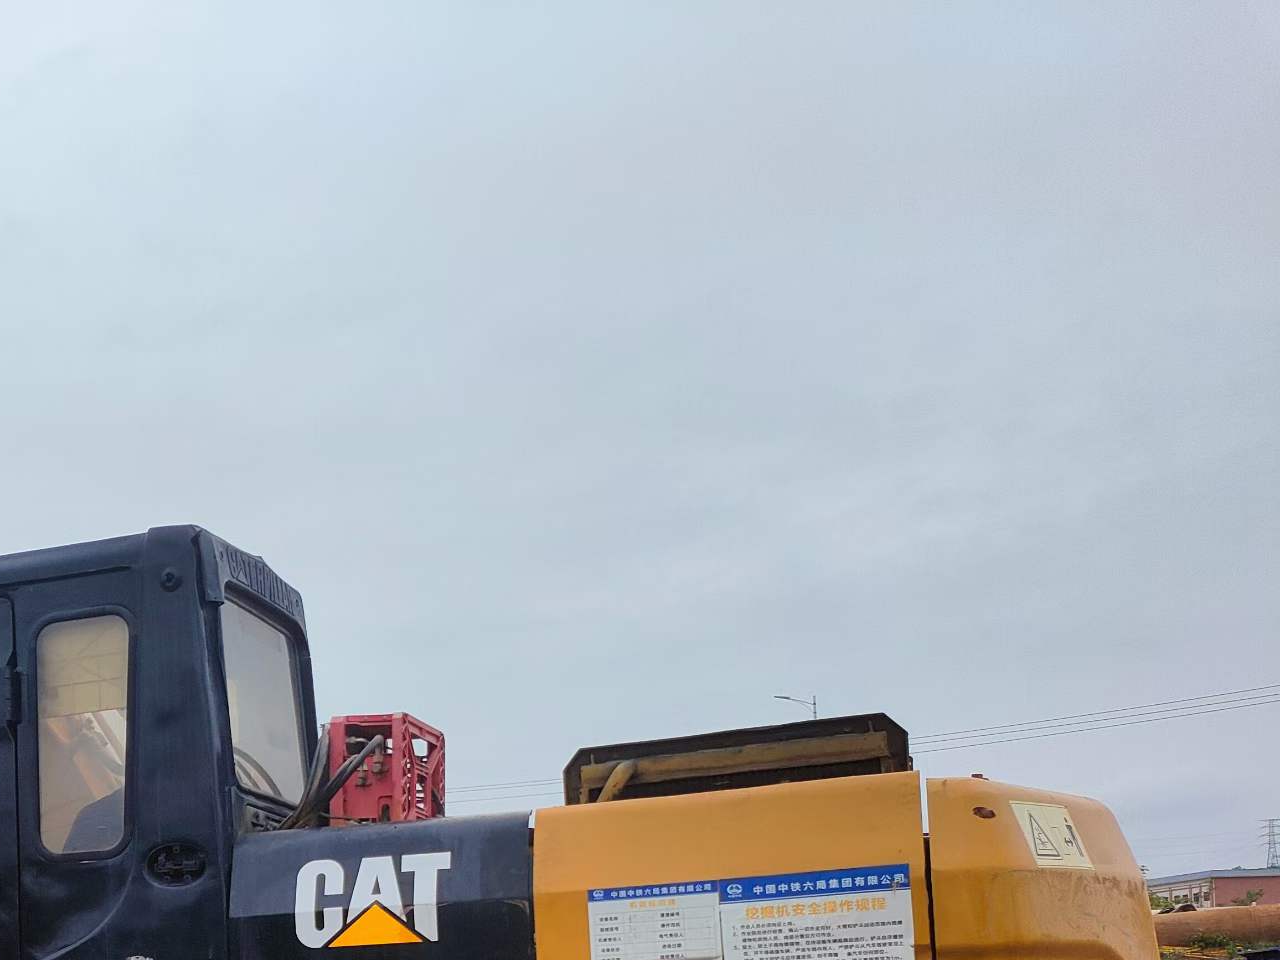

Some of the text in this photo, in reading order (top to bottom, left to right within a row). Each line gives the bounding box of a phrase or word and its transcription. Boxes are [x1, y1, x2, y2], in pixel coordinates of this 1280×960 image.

[752, 873, 905, 895] 中国中铁六局集团有限公司
[294, 851, 452, 949] CAT
[745, 897, 889, 919] 挖掘机安全操作规程
